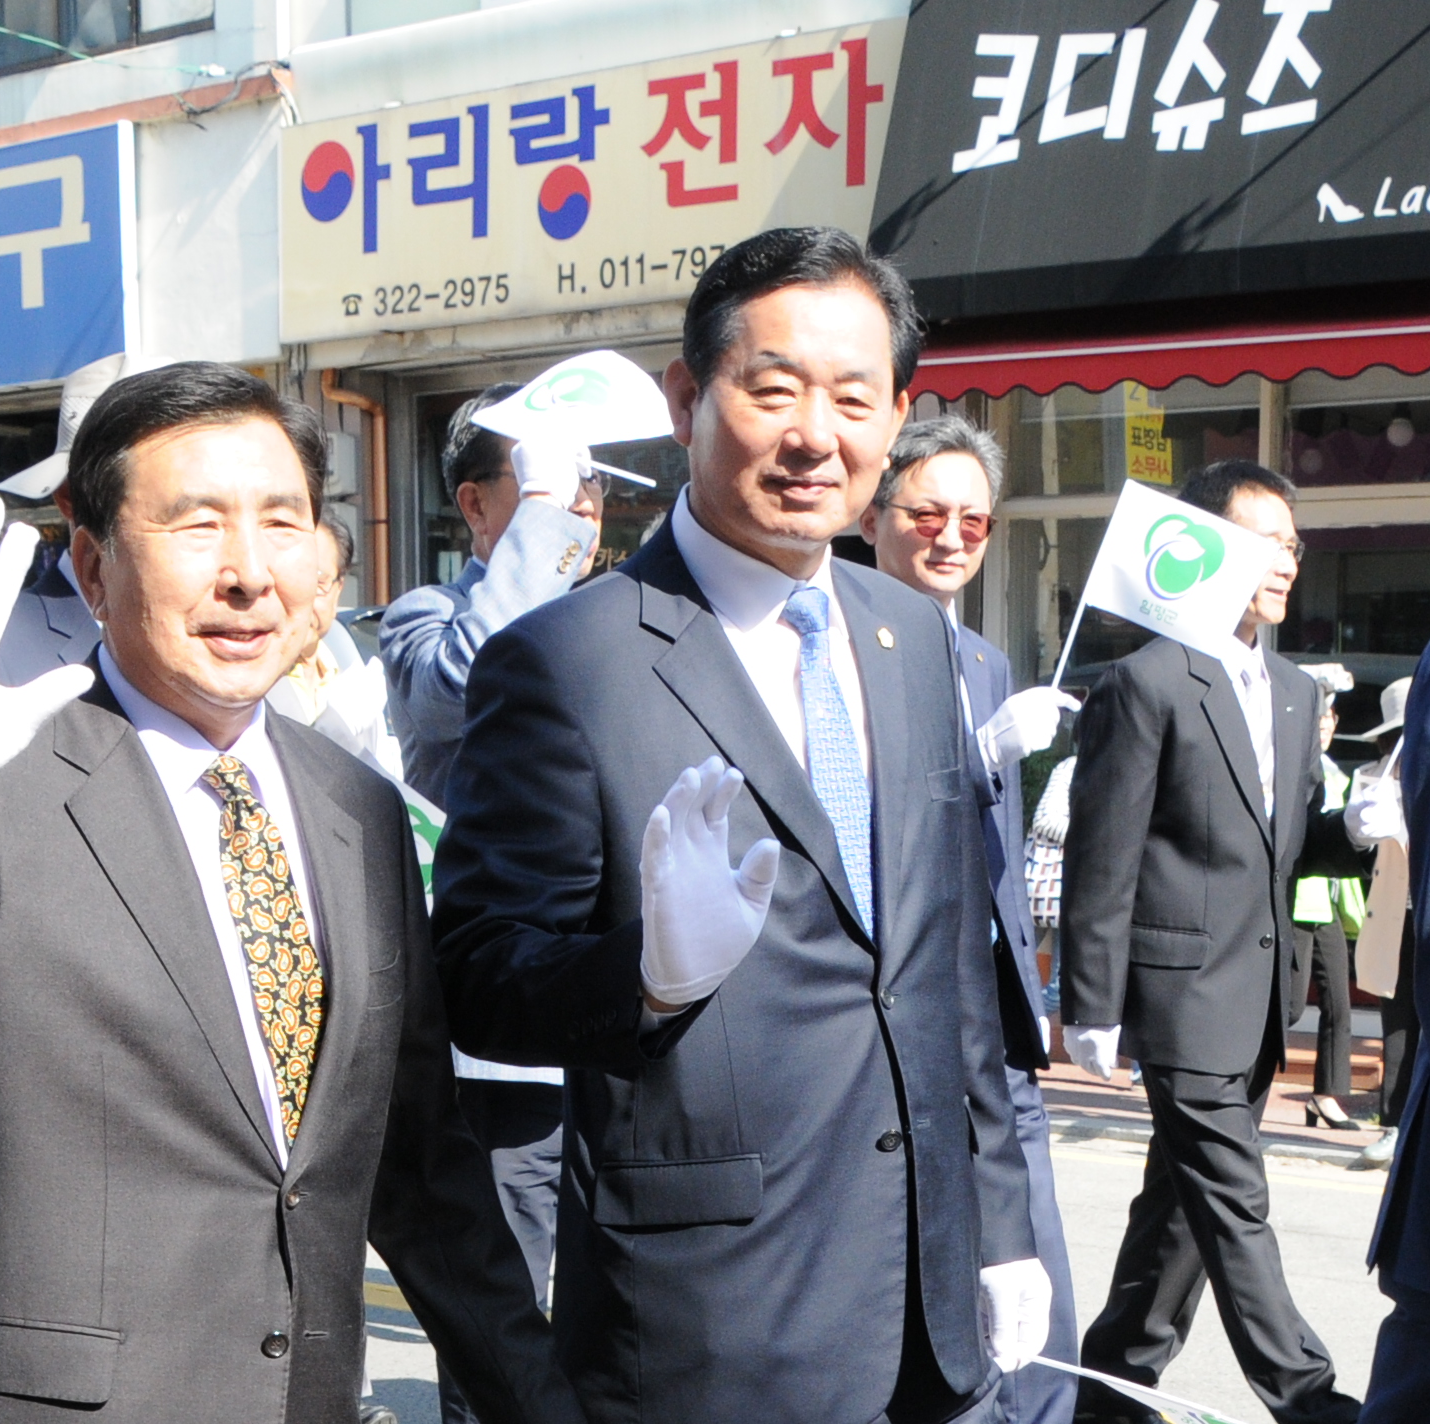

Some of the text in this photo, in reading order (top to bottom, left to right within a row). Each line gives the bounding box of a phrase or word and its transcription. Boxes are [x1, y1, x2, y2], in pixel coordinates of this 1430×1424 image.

[301, 37, 884, 254] 아리랑 전자
[952, 0, 1333, 173] 코디슈즈
[373, 273, 509, 317] 322-2975
